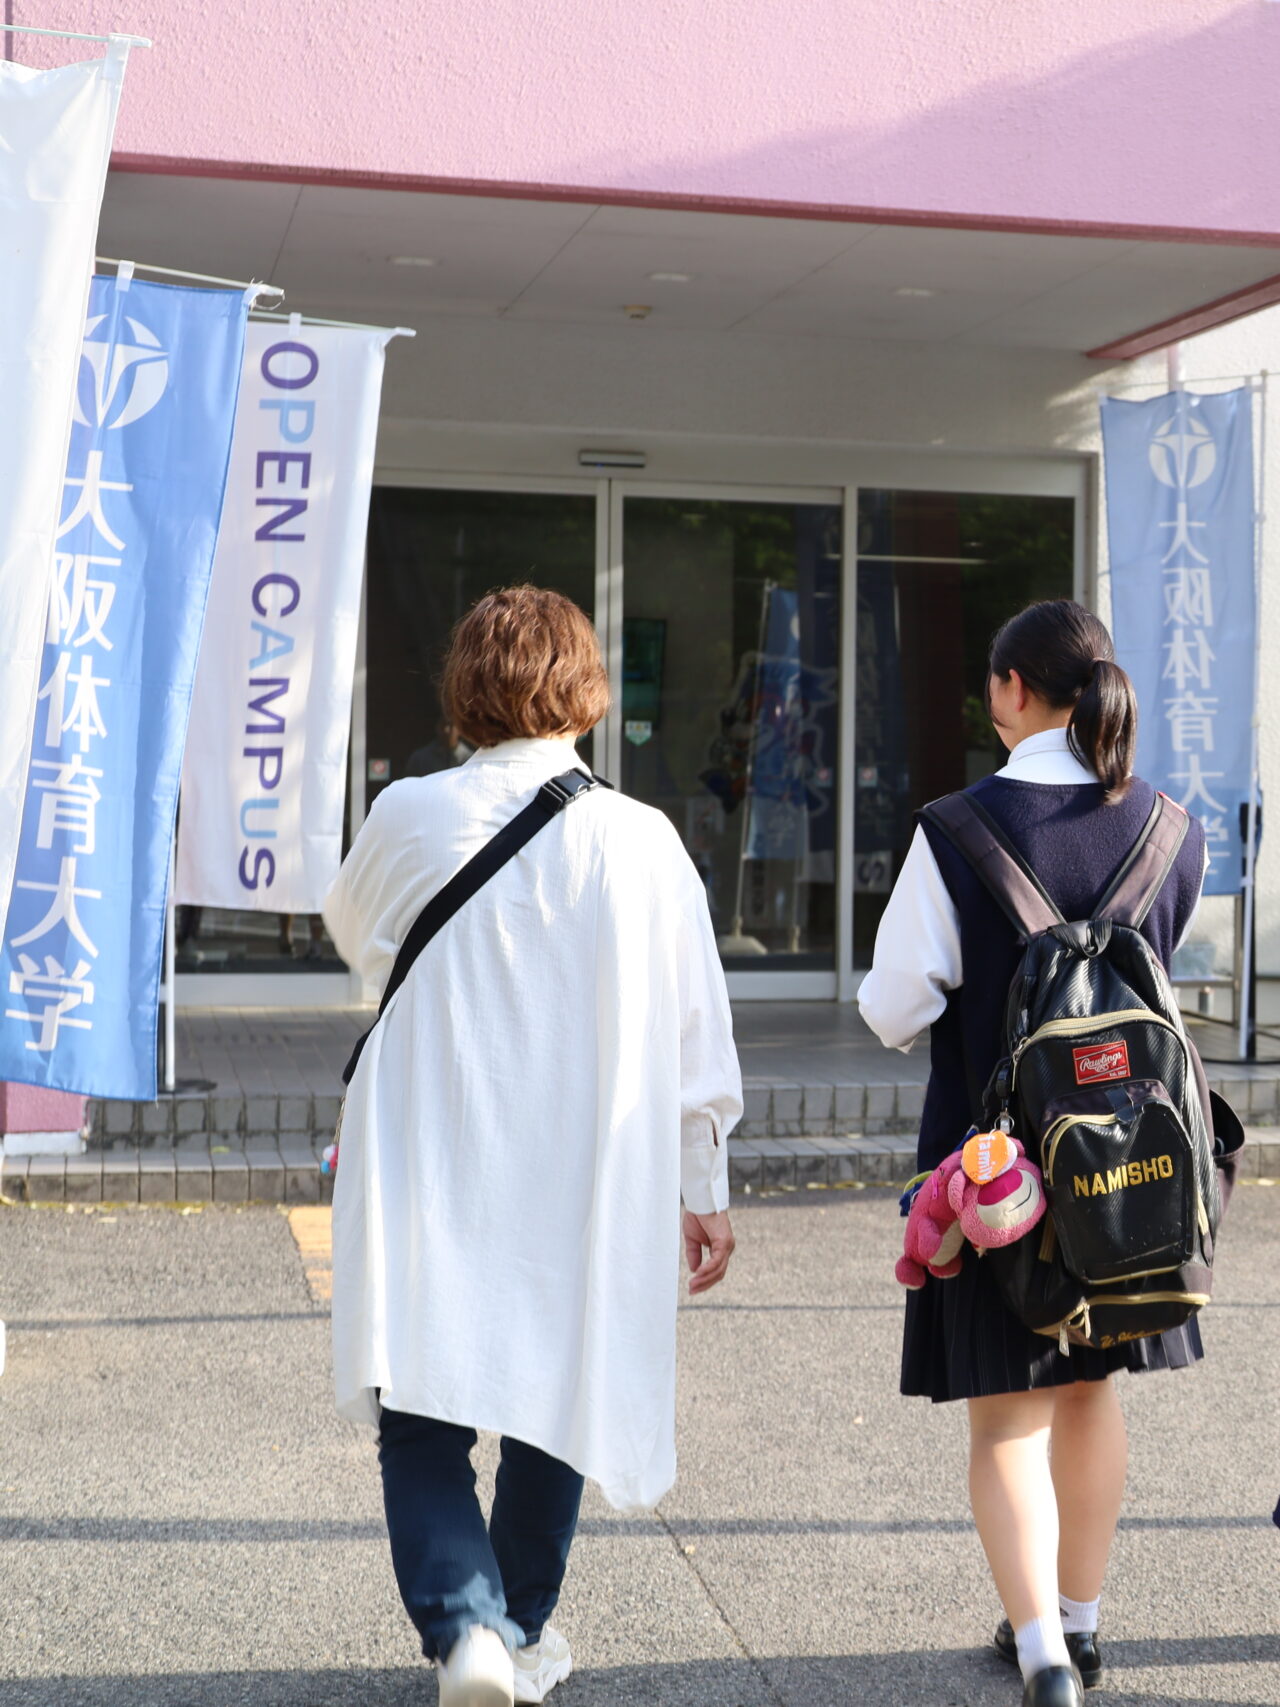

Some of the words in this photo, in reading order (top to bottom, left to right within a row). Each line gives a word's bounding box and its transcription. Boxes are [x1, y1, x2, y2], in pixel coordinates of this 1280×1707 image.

[255, 342, 320, 543] OPEN
[5, 451, 134, 1052] 大阪体育大学
[238, 572, 301, 891] CAMPUS
[1080, 1052, 1123, 1072] Rawlings
[1073, 1155, 1174, 1197] NAMISHO
